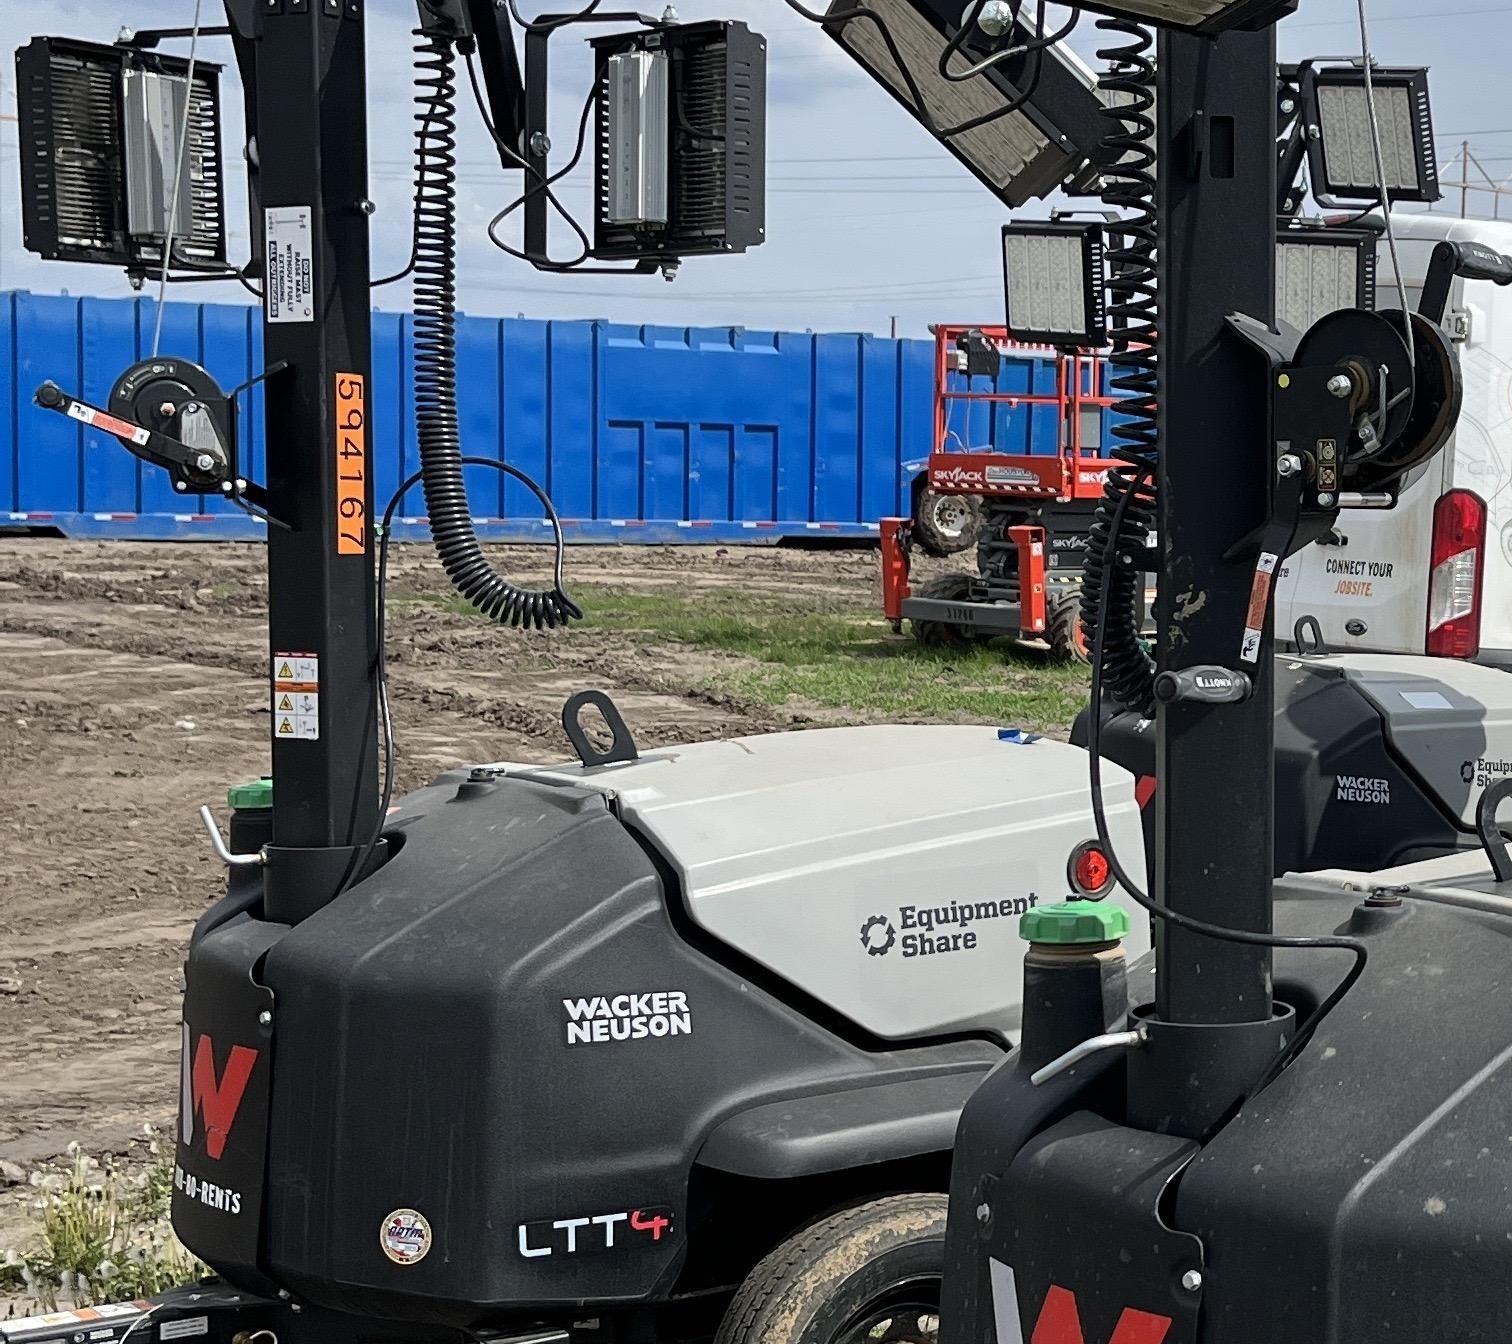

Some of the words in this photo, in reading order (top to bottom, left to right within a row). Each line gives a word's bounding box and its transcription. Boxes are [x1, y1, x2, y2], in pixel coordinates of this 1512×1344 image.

[338, 378, 365, 548] 594167
[934, 466, 983, 483] SKYJACK
[1052, 535, 1090, 549] SKYJAC
[1325, 558, 1367, 576] CONNECT
[1368, 562, 1394, 578] YOUR
[1336, 774, 1390, 792] WACKER
[1336, 787, 1390, 804] NEUSON
[899, 890, 1039, 931] Equipment
[900, 931, 978, 958] Share
[562, 990, 690, 1022] WACKER
[567, 1012, 693, 1045] NEUSON
[518, 1210, 669, 1258] LTT4
